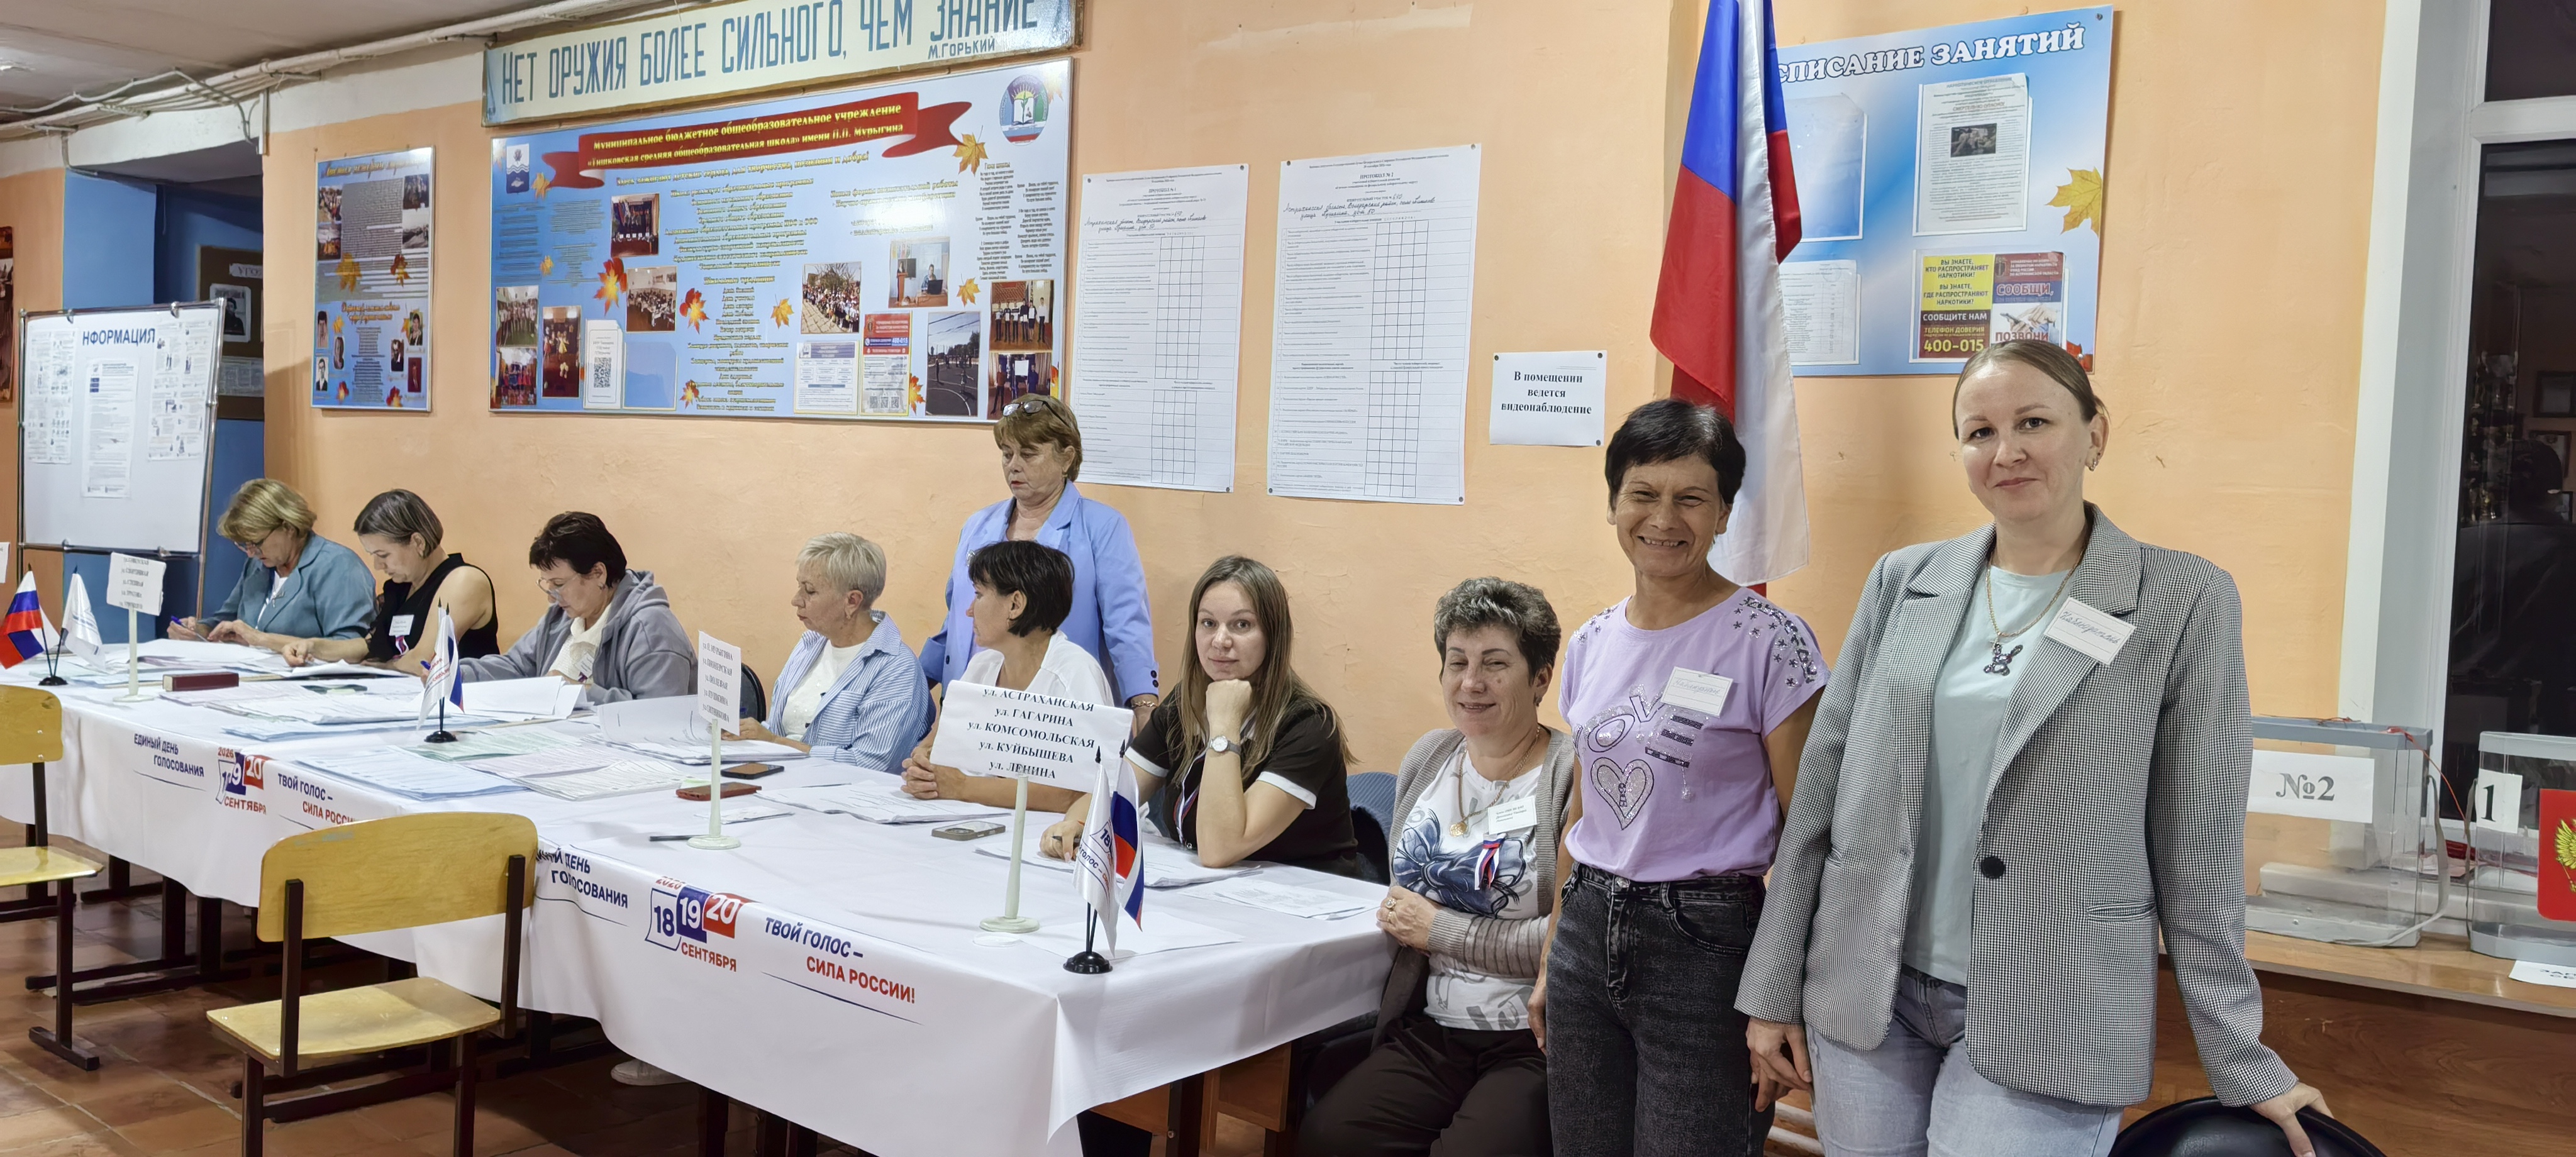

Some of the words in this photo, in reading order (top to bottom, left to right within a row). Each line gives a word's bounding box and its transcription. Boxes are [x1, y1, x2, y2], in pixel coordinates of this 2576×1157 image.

[502, 52, 536, 104] НЕТ
[549, 36, 627, 98] ОРУЖИЯ
[640, 22, 706, 86] БОЛЕЕ
[721, 0, 847, 74] СИЛЬНОГО,
[860, 0, 912, 52] ЧЕМ
[930, 0, 1038, 42] ЗНАНИЕ
[1778, 46, 1924, 84] СПИСАНИЕ
[1931, 22, 2085, 65] ЗАНЯТИЙ
[594, 133, 663, 150] Муниципальное
[665, 128, 719, 142] бюджетное
[721, 113, 831, 135] общеобразовательное
[834, 103, 901, 125] учреждение
[640, 150, 672, 162] средняя
[674, 142, 765, 157] общеобразовательная
[802, 131, 830, 143] имени
[854, 123, 903, 139] Мурыгина
[1997, 283, 2054, 296] СООБЩИ,
[1968, 313, 1987, 321] НАМ
[82, 328, 155, 346] НФОРМАЦИЯ
[1924, 339, 1984, 353] 400-015
[1514, 371, 1521, 381] В
[1524, 374, 1583, 384] помещении
[1528, 389, 1566, 397] ведется
[1501, 402, 1592, 414] видеонаблюдение
[1000, 690, 1094, 712] АСТРАХАНСКАЯ
[1013, 709, 1074, 727] ГАГАРИНА
[134, 733, 161, 750] ЕДИНЫЙ
[162, 741, 179, 755] ДЕНЬ
[985, 722, 1095, 749] КОМСОМОЛЬСКАЯ
[978, 740, 994, 751] ул.
[996, 741, 1074, 763] КУЙБЫШЕВА
[153, 755, 204, 777] ГОЛОСОВАНИЯ
[246, 756, 262, 780] 20
[989, 761, 1003, 771] ул.
[1006, 763, 1056, 779] ЛЕНИНА
[278, 773, 298, 791] ТВОЙ
[300, 780, 326, 800] ГОЛОС
[2275, 772, 2335, 802] №2
[225, 795, 267, 816] СЕНТЯБРЯ
[303, 800, 323, 819] СИЛА
[565, 853, 591, 874] ДЕНЬ
[653, 905, 675, 938] 18
[679, 897, 701, 929] 19
[706, 895, 741, 925] 20
[765, 917, 803, 943] ТВОЙ
[803, 929, 851, 958] ГОЛОС
[681, 941, 736, 972] СЕНТЯБРЯ
[807, 956, 845, 982] СИЛА
[849, 968, 915, 1004] РОССИИ!
